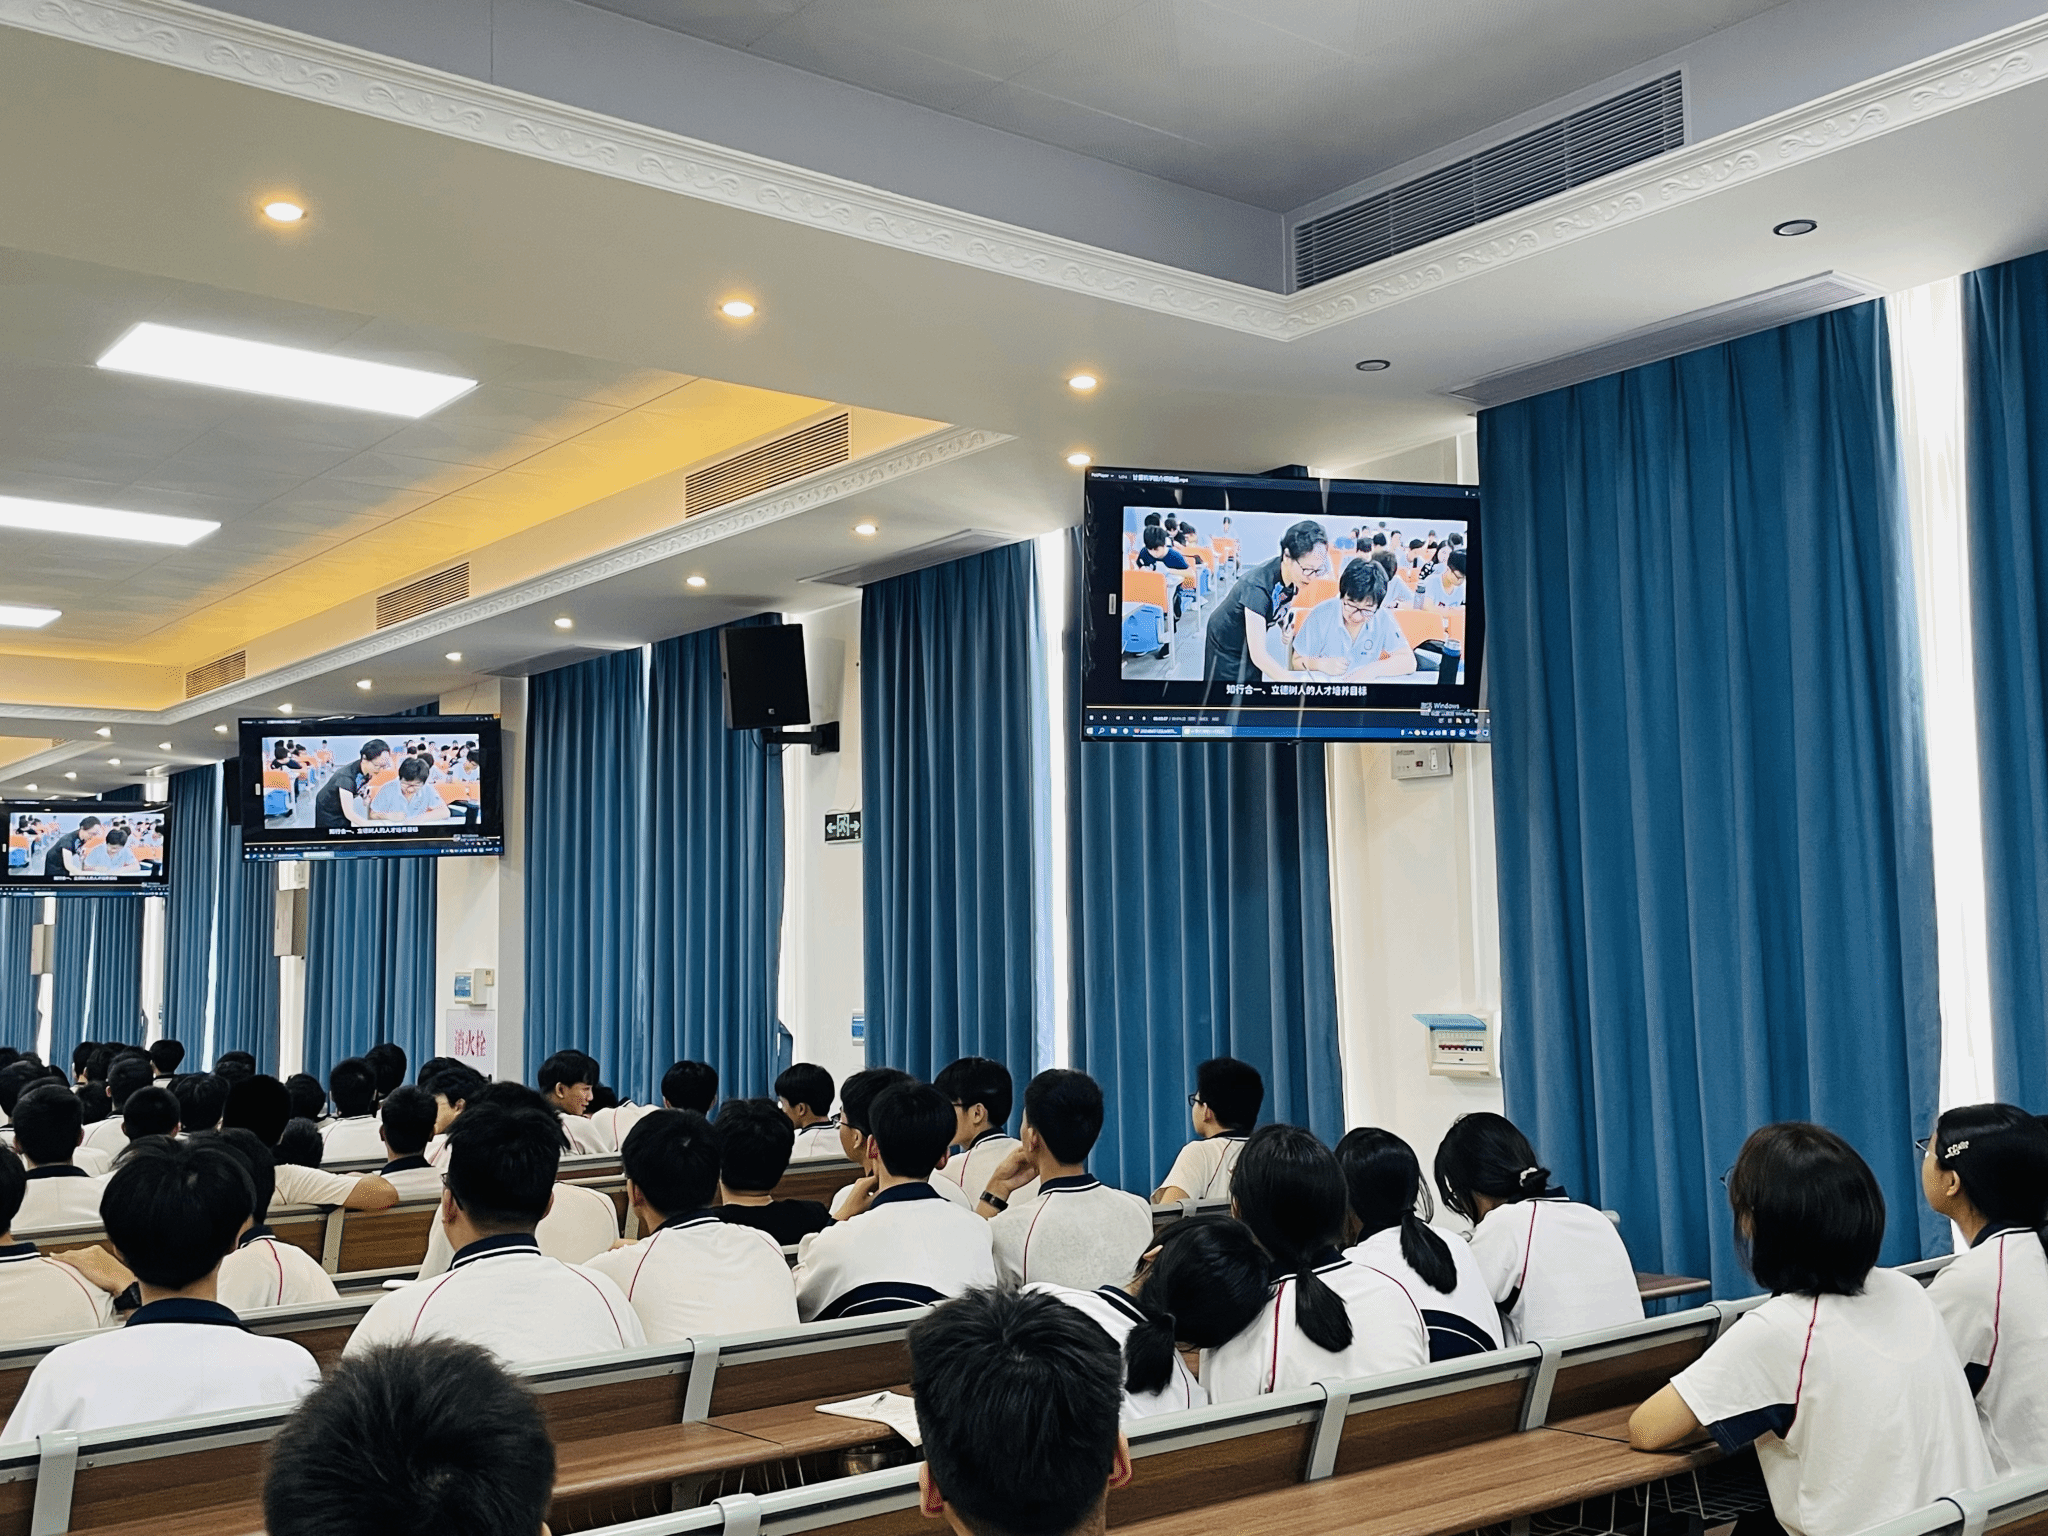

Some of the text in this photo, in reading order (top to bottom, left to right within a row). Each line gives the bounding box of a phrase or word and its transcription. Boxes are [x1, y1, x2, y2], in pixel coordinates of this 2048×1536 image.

[1226, 684, 1367, 697] 知行合一、立德树人的人才培养目标
[454, 1028, 486, 1057] 消火栓
